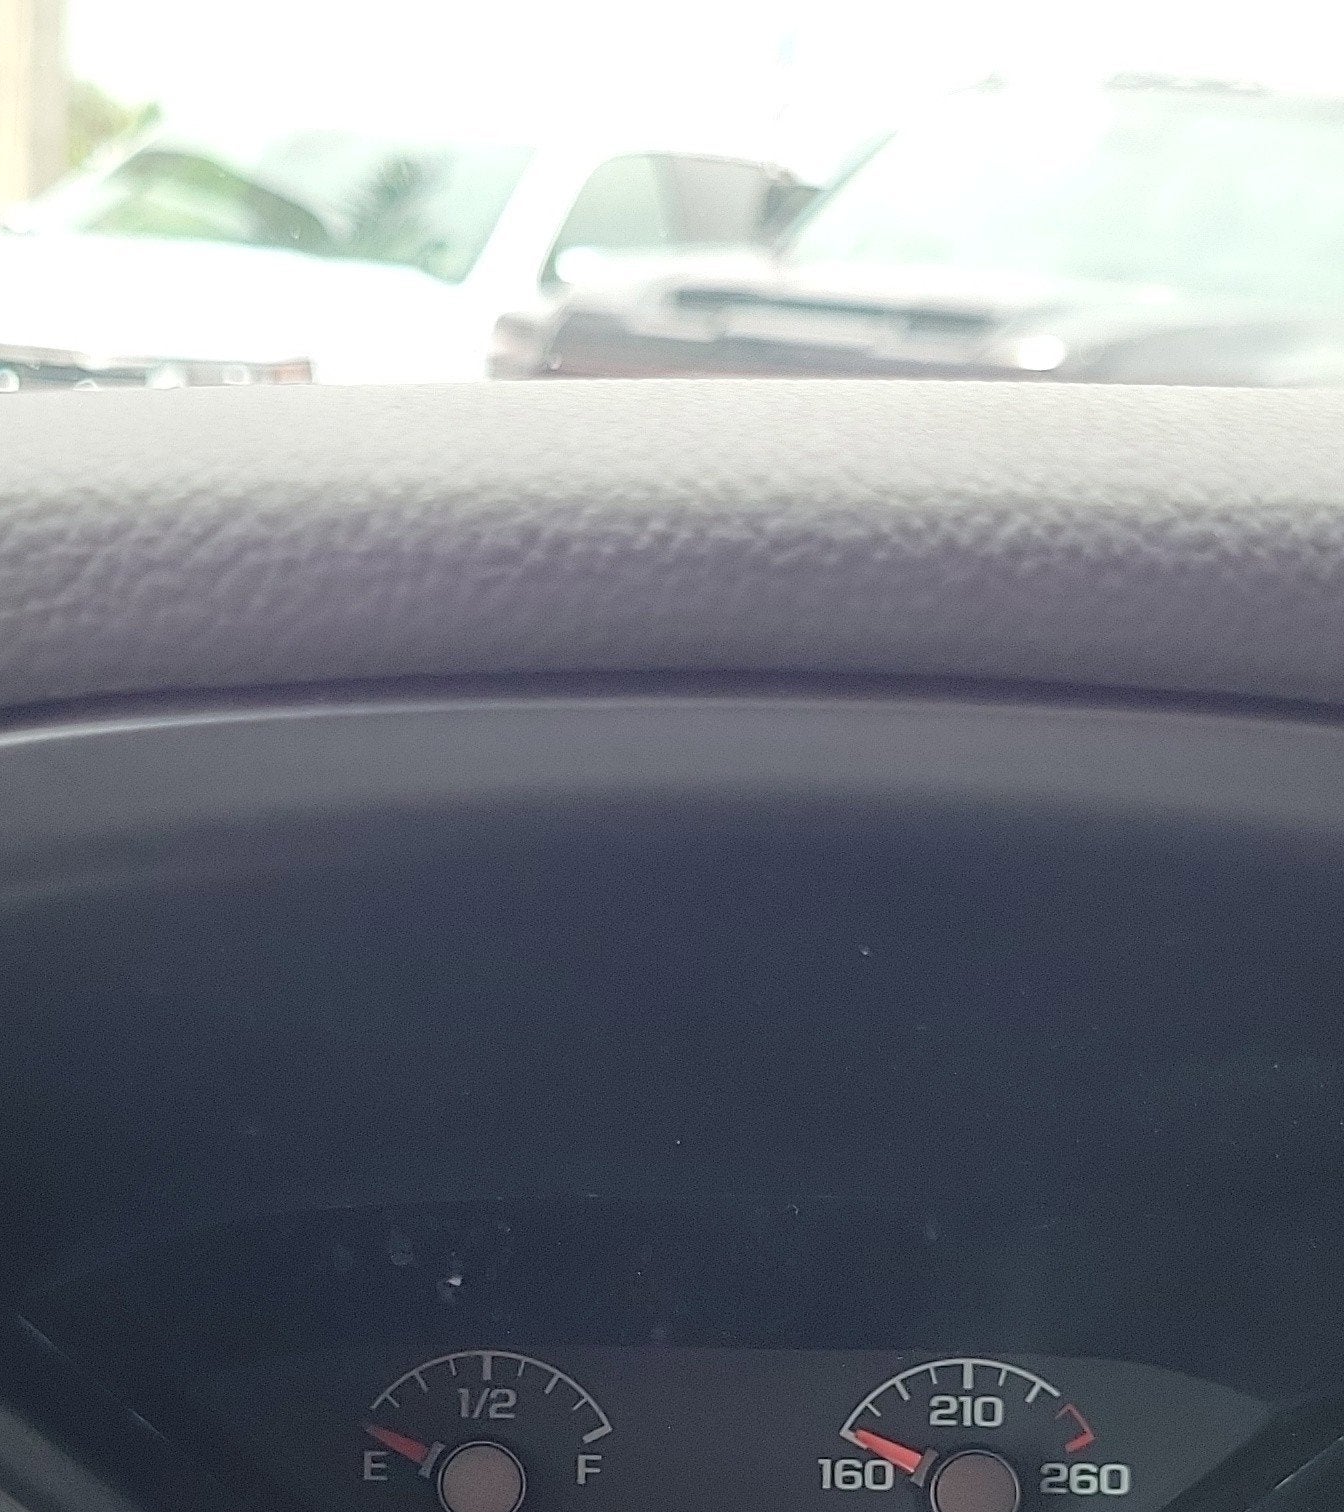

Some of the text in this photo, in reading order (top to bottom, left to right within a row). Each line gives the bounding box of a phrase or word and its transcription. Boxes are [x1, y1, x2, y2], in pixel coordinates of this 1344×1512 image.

[457, 1387, 518, 1420] 1/2
[928, 1394, 1005, 1428] 210
[362, 1449, 389, 1482] E
[576, 1453, 603, 1486] F
[819, 1457, 896, 1492] 160
[1041, 1462, 1131, 1496] 260
